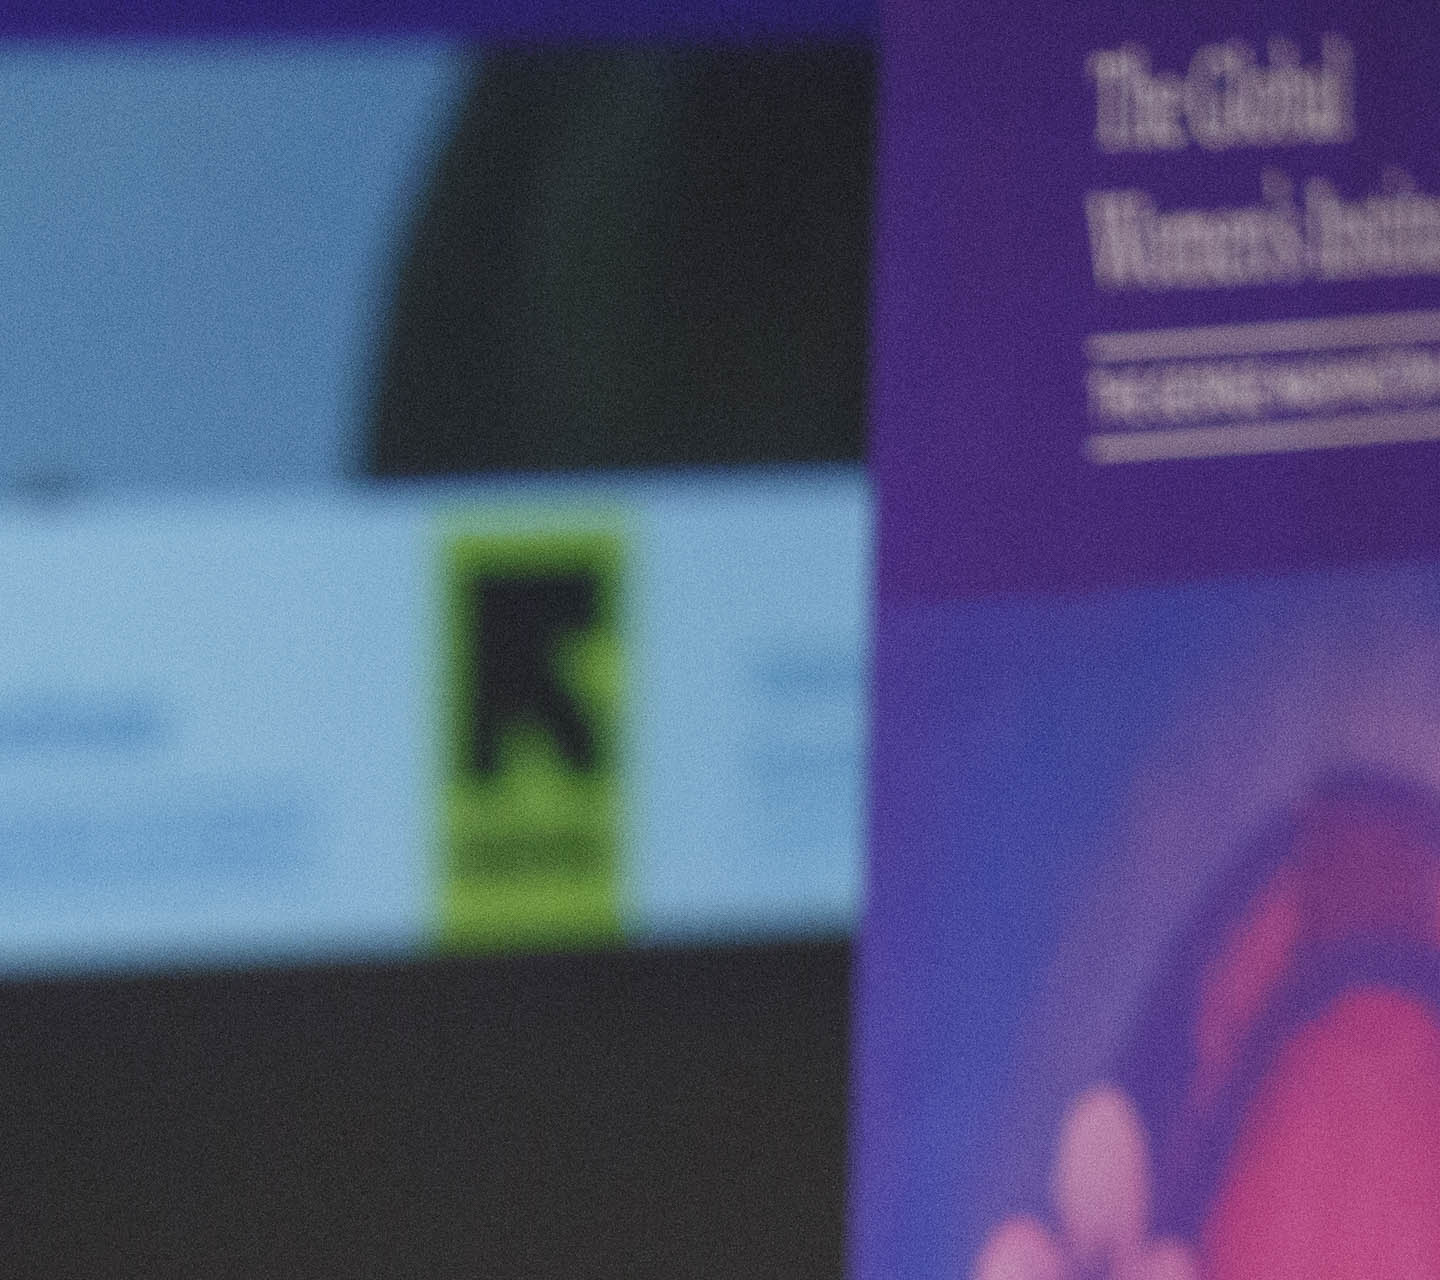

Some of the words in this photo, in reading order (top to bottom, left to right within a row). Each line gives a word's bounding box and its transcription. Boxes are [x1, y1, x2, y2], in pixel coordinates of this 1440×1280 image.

[1088, 42, 1182, 150] The
[1188, 35, 1352, 148] Global
[1088, 170, 1304, 288] Women's
